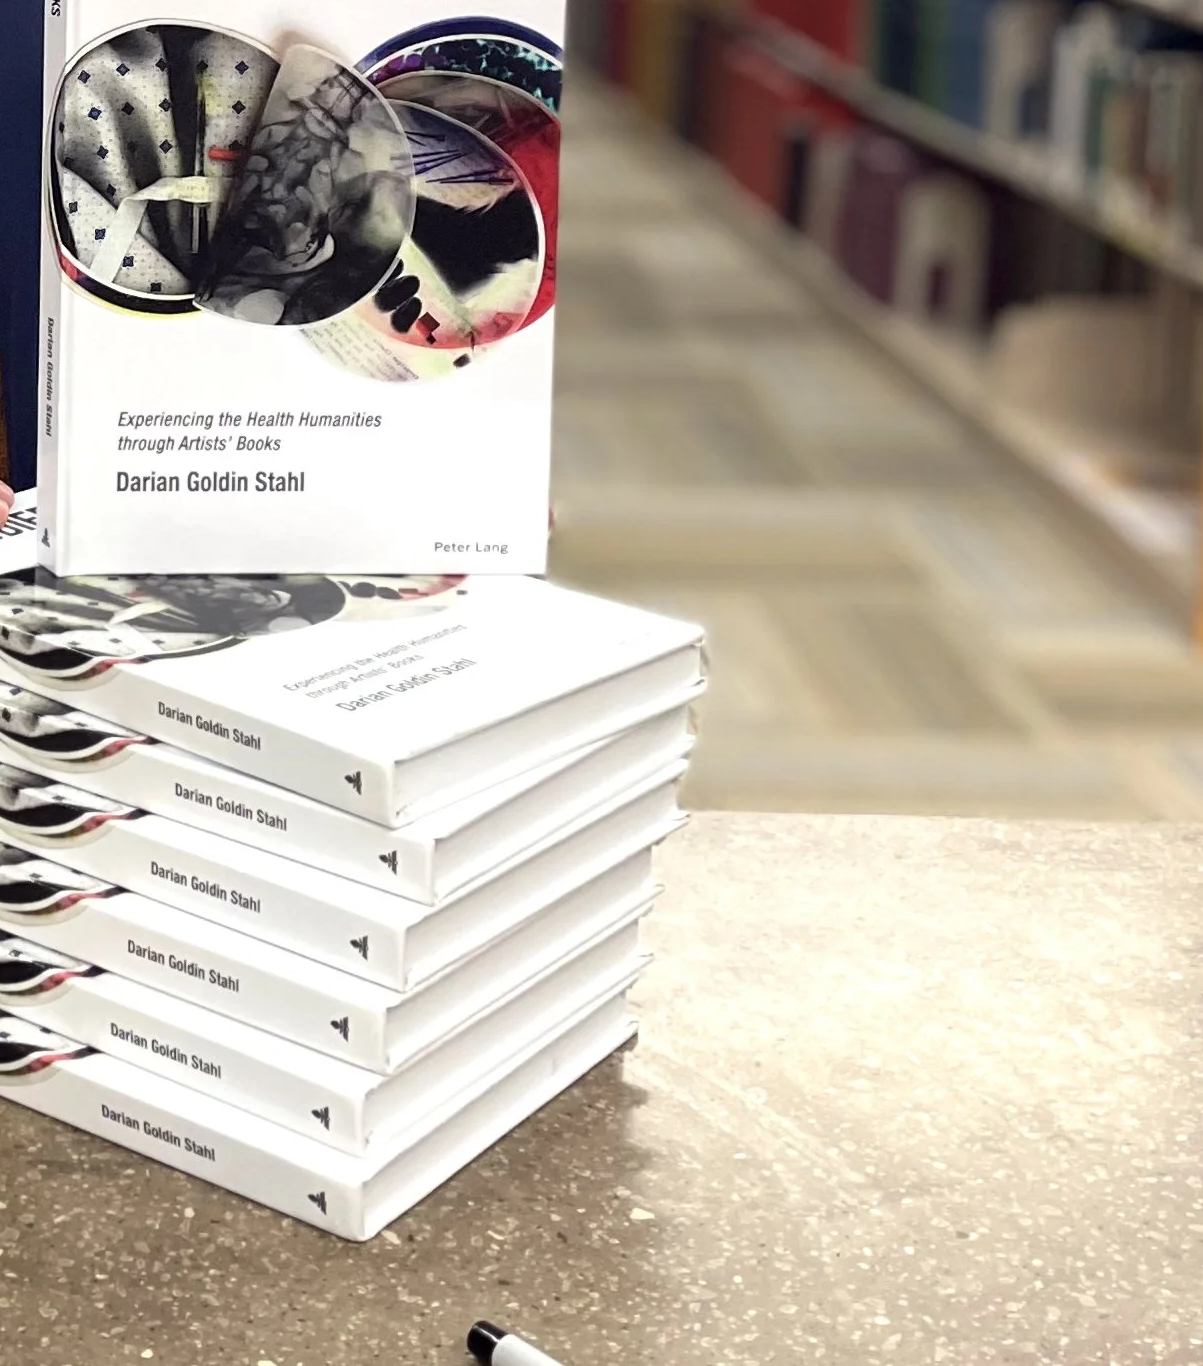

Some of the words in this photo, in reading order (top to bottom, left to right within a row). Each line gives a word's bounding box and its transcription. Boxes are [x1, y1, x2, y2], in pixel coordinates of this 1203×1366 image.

[47, 317, 55, 359] Darian
[46, 361, 54, 401] Goldin
[45, 404, 53, 438] Stahl
[117, 411, 214, 430] Experiencing
[218, 411, 242, 427] the
[246, 411, 295, 427] Health
[298, 411, 382, 428] Humanities
[117, 435, 175, 454] through
[178, 435, 233, 451] Artists'
[236, 435, 282, 451] Books
[116, 471, 180, 492] Darian
[187, 471, 248, 492] Goldin
[255, 471, 305, 492] Stahl
[434, 541, 471, 553] Peter
[475, 541, 509, 555] Lang
[335, 689, 393, 712] Darian
[385, 671, 438, 694] Goldin
[432, 657, 477, 676] Stahl
[159, 702, 192, 725] Darian
[196, 715, 229, 739] Goldin
[233, 729, 260, 750] Stahl
[175, 783, 212, 806] Darian
[216, 796, 252, 820] Goldin
[257, 809, 286, 831] Stahl
[151, 861, 187, 886] Darian
[191, 876, 227, 901] Goldin
[231, 890, 260, 913] Stahl
[128, 940, 164, 965] Darian
[169, 955, 205, 980] Goldin
[209, 969, 239, 992] Stahl
[111, 1023, 147, 1049] Darian
[152, 1039, 187, 1065] Goldin
[192, 1055, 221, 1078] Stahl
[102, 1104, 139, 1130] Darian
[144, 1121, 180, 1147] Goldin
[185, 1138, 215, 1161] Stahl
